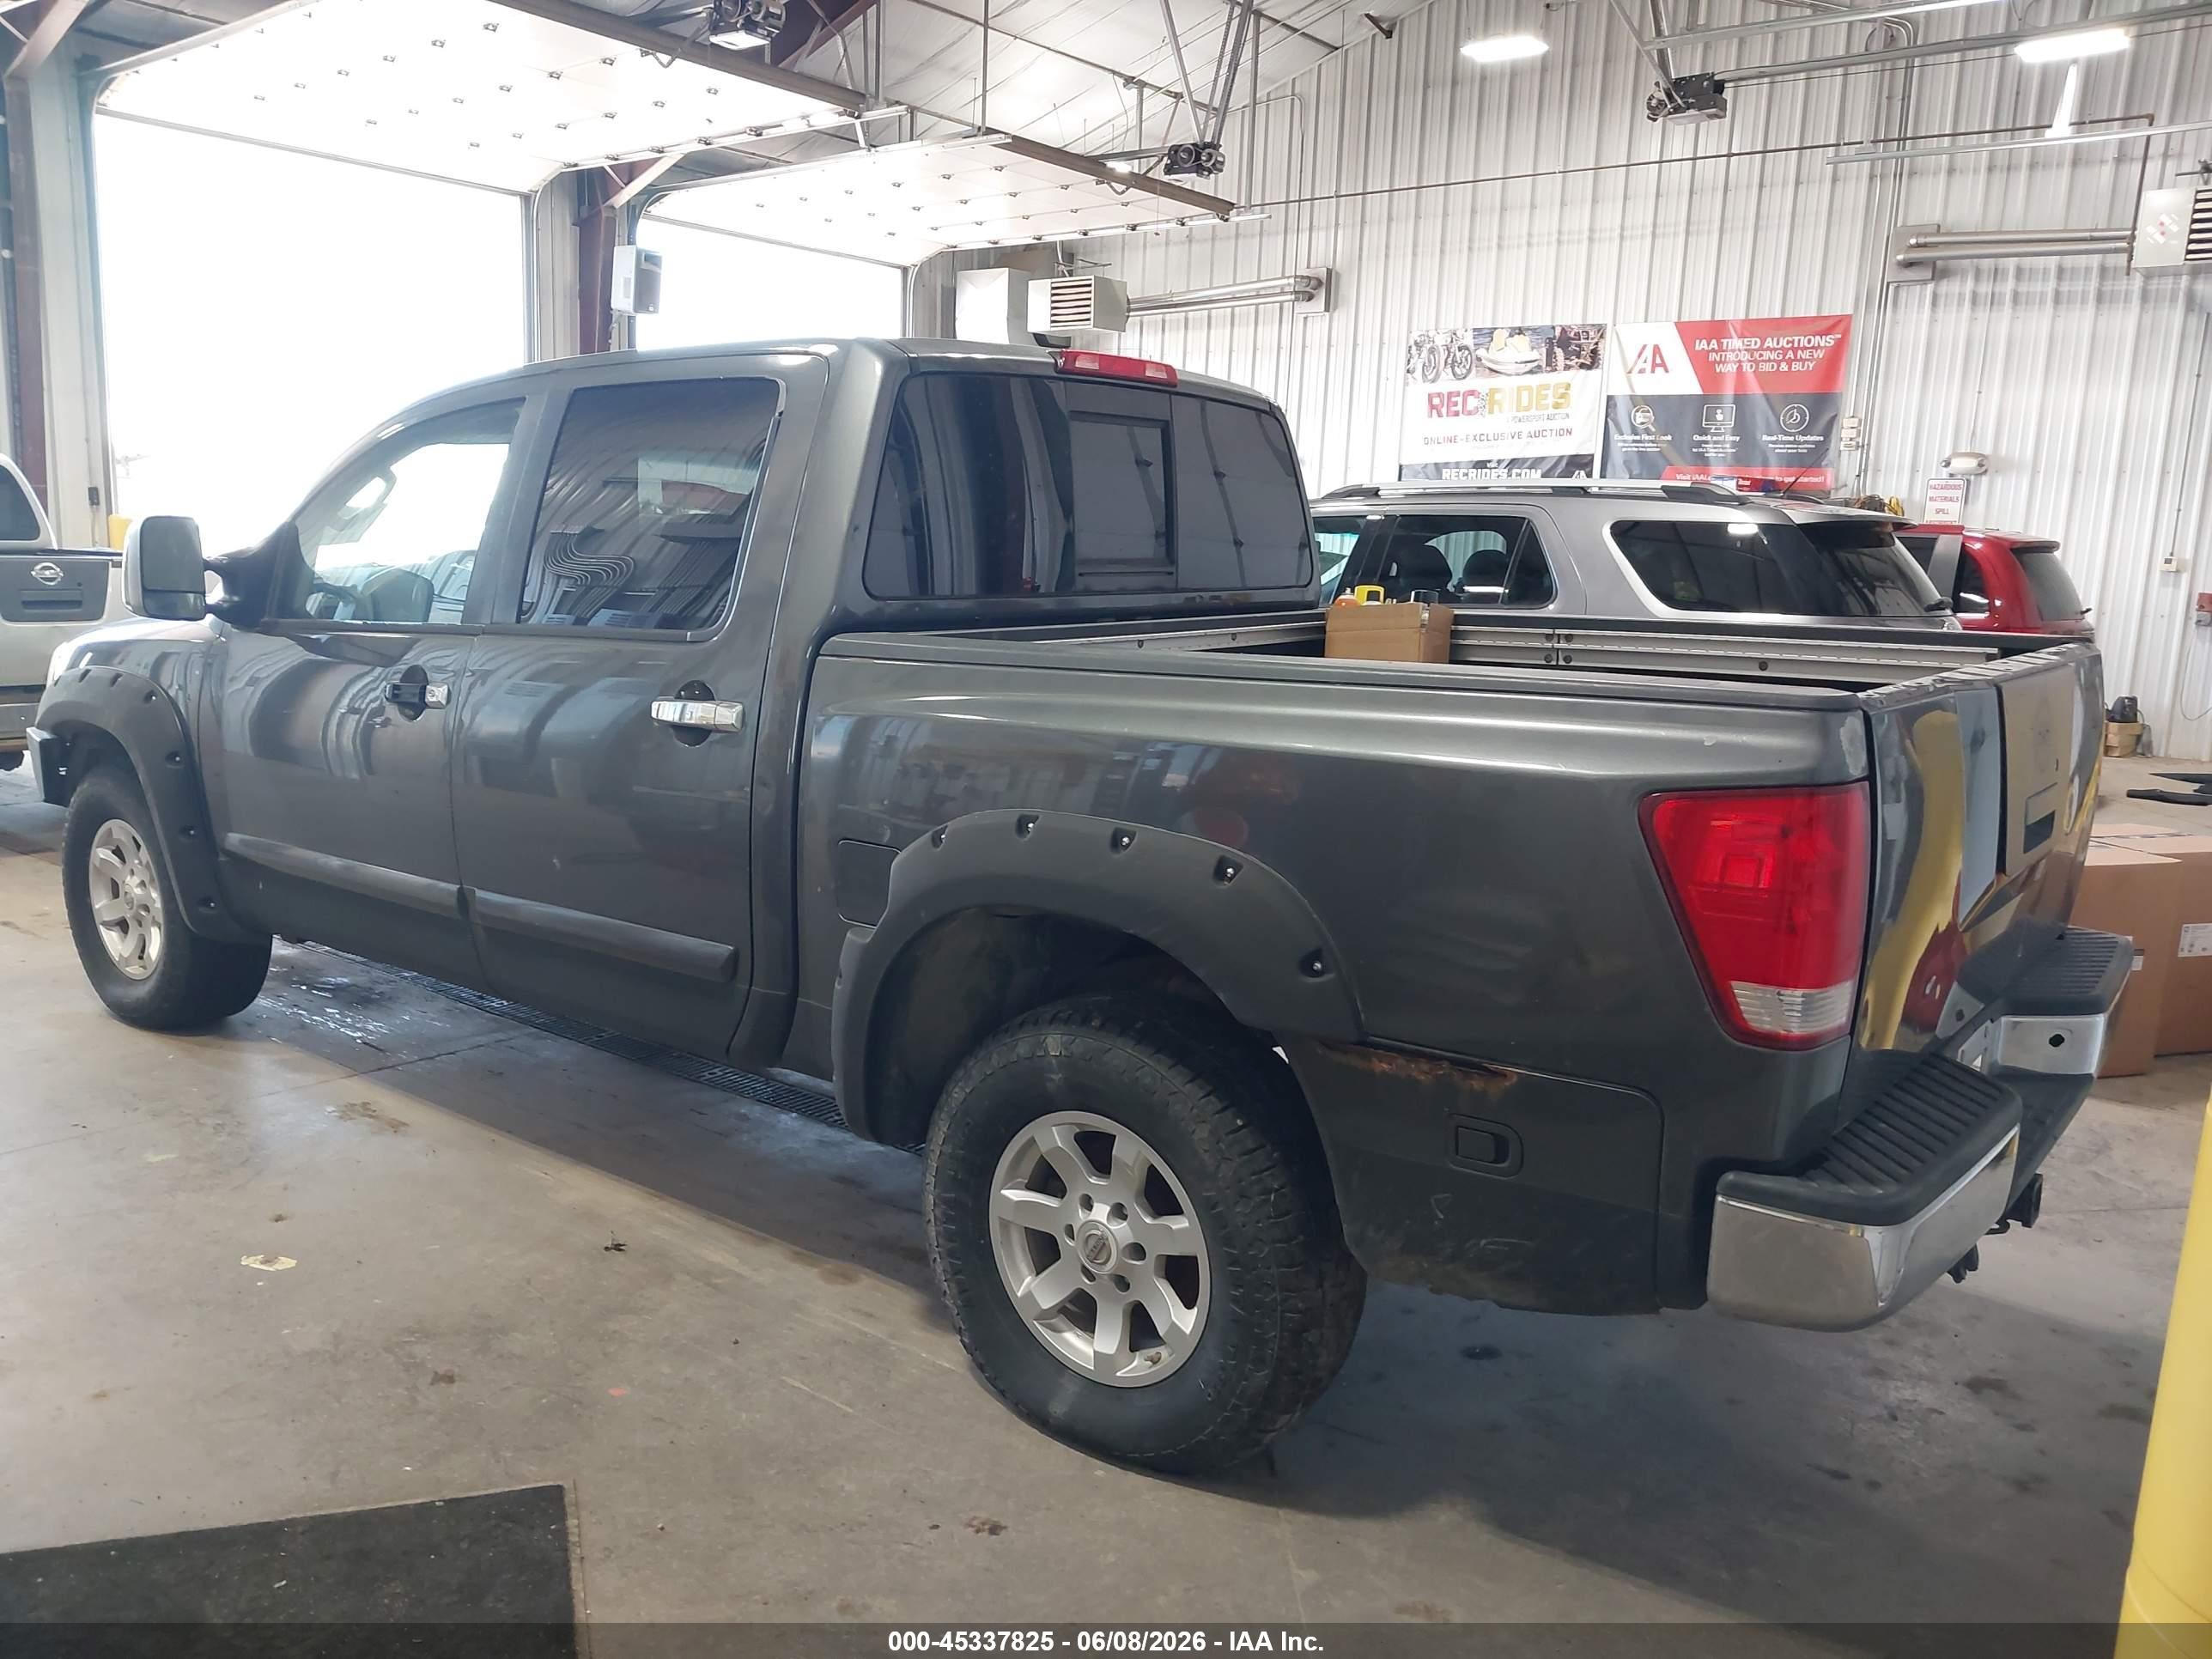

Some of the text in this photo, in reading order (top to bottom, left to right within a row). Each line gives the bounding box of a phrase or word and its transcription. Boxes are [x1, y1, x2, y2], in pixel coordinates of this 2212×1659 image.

[1695, 338, 1719, 350] IAA
[1721, 337, 1761, 349] TIMED
[1708, 349, 1825, 361] INTRODUCING A NEW
[1715, 361, 1817, 373] WAY TO BID & BUY
[1424, 428, 1573, 445] ONLINE-EXCLUSIVE AUCTION
[1442, 468, 1542, 480] RECRIDES.COM
